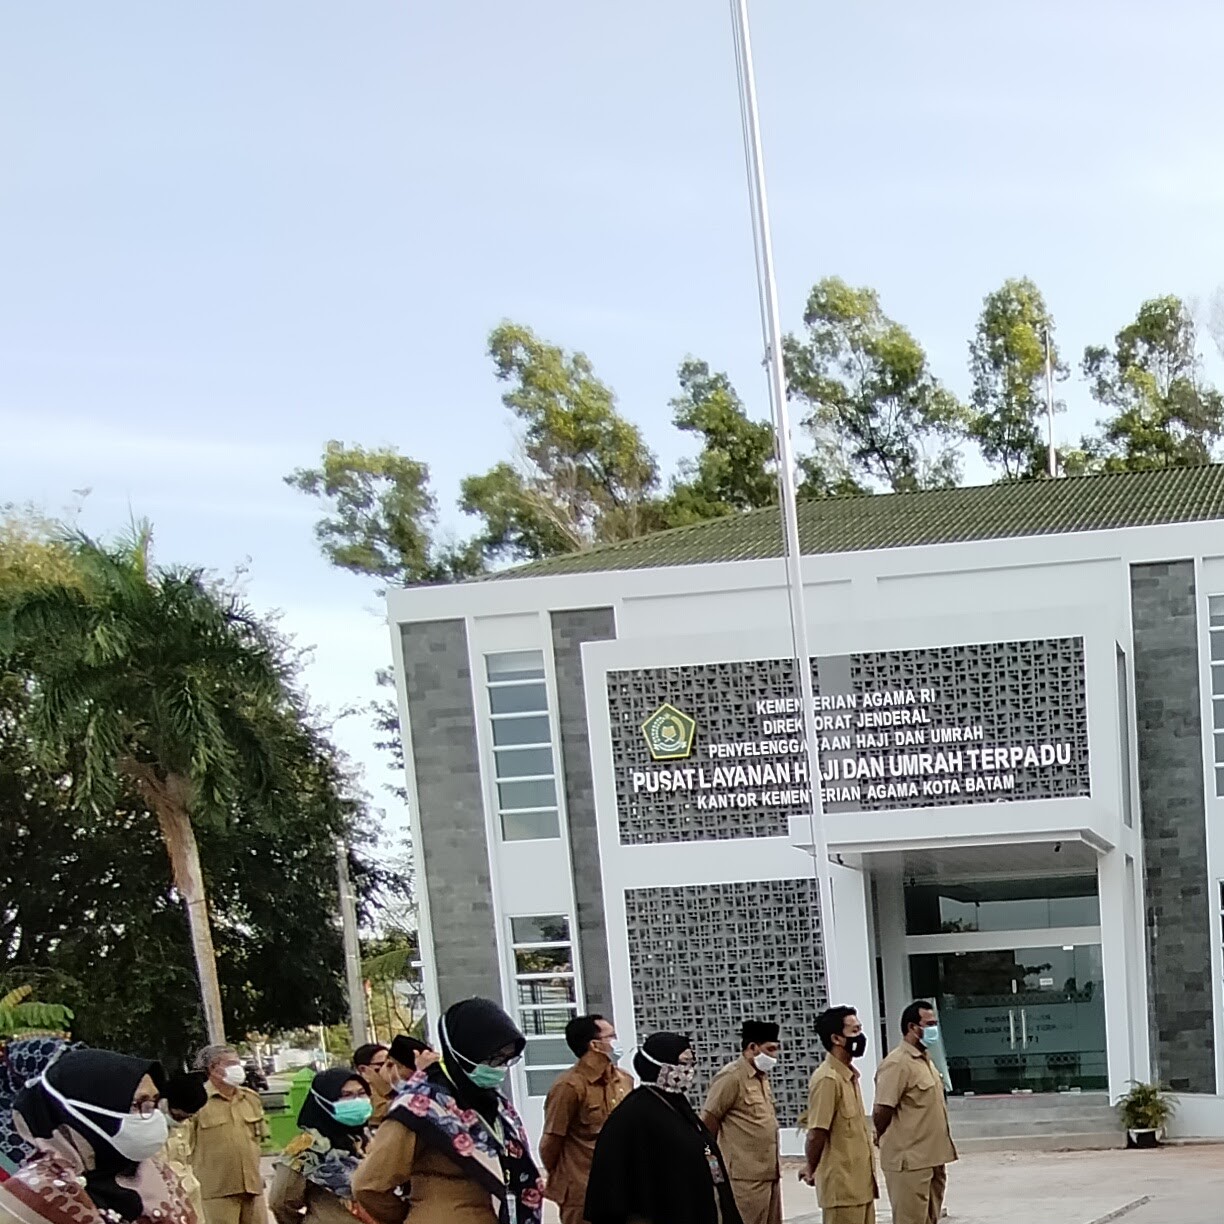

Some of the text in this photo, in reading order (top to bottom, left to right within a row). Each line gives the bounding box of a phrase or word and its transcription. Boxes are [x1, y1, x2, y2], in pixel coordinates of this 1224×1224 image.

[756, 688, 936, 715] KEMENERIAN AGAMA RI
[763, 708, 931, 735] DIREKORAT JENDERAL
[708, 725, 983, 758] PENYELENGGAAAN HAJI DAN UMRAH
[633, 769, 696, 793] PUSAT
[699, 762, 791, 789] LAYANAN
[843, 756, 885, 779] DAN
[889, 751, 963, 777] UMRAH
[967, 743, 1071, 771] TERPADU
[697, 791, 758, 809] KANTOR
[867, 782, 919, 799] AGAMA
[923, 779, 961, 795] KOTA
[965, 774, 1015, 792] BATAM
